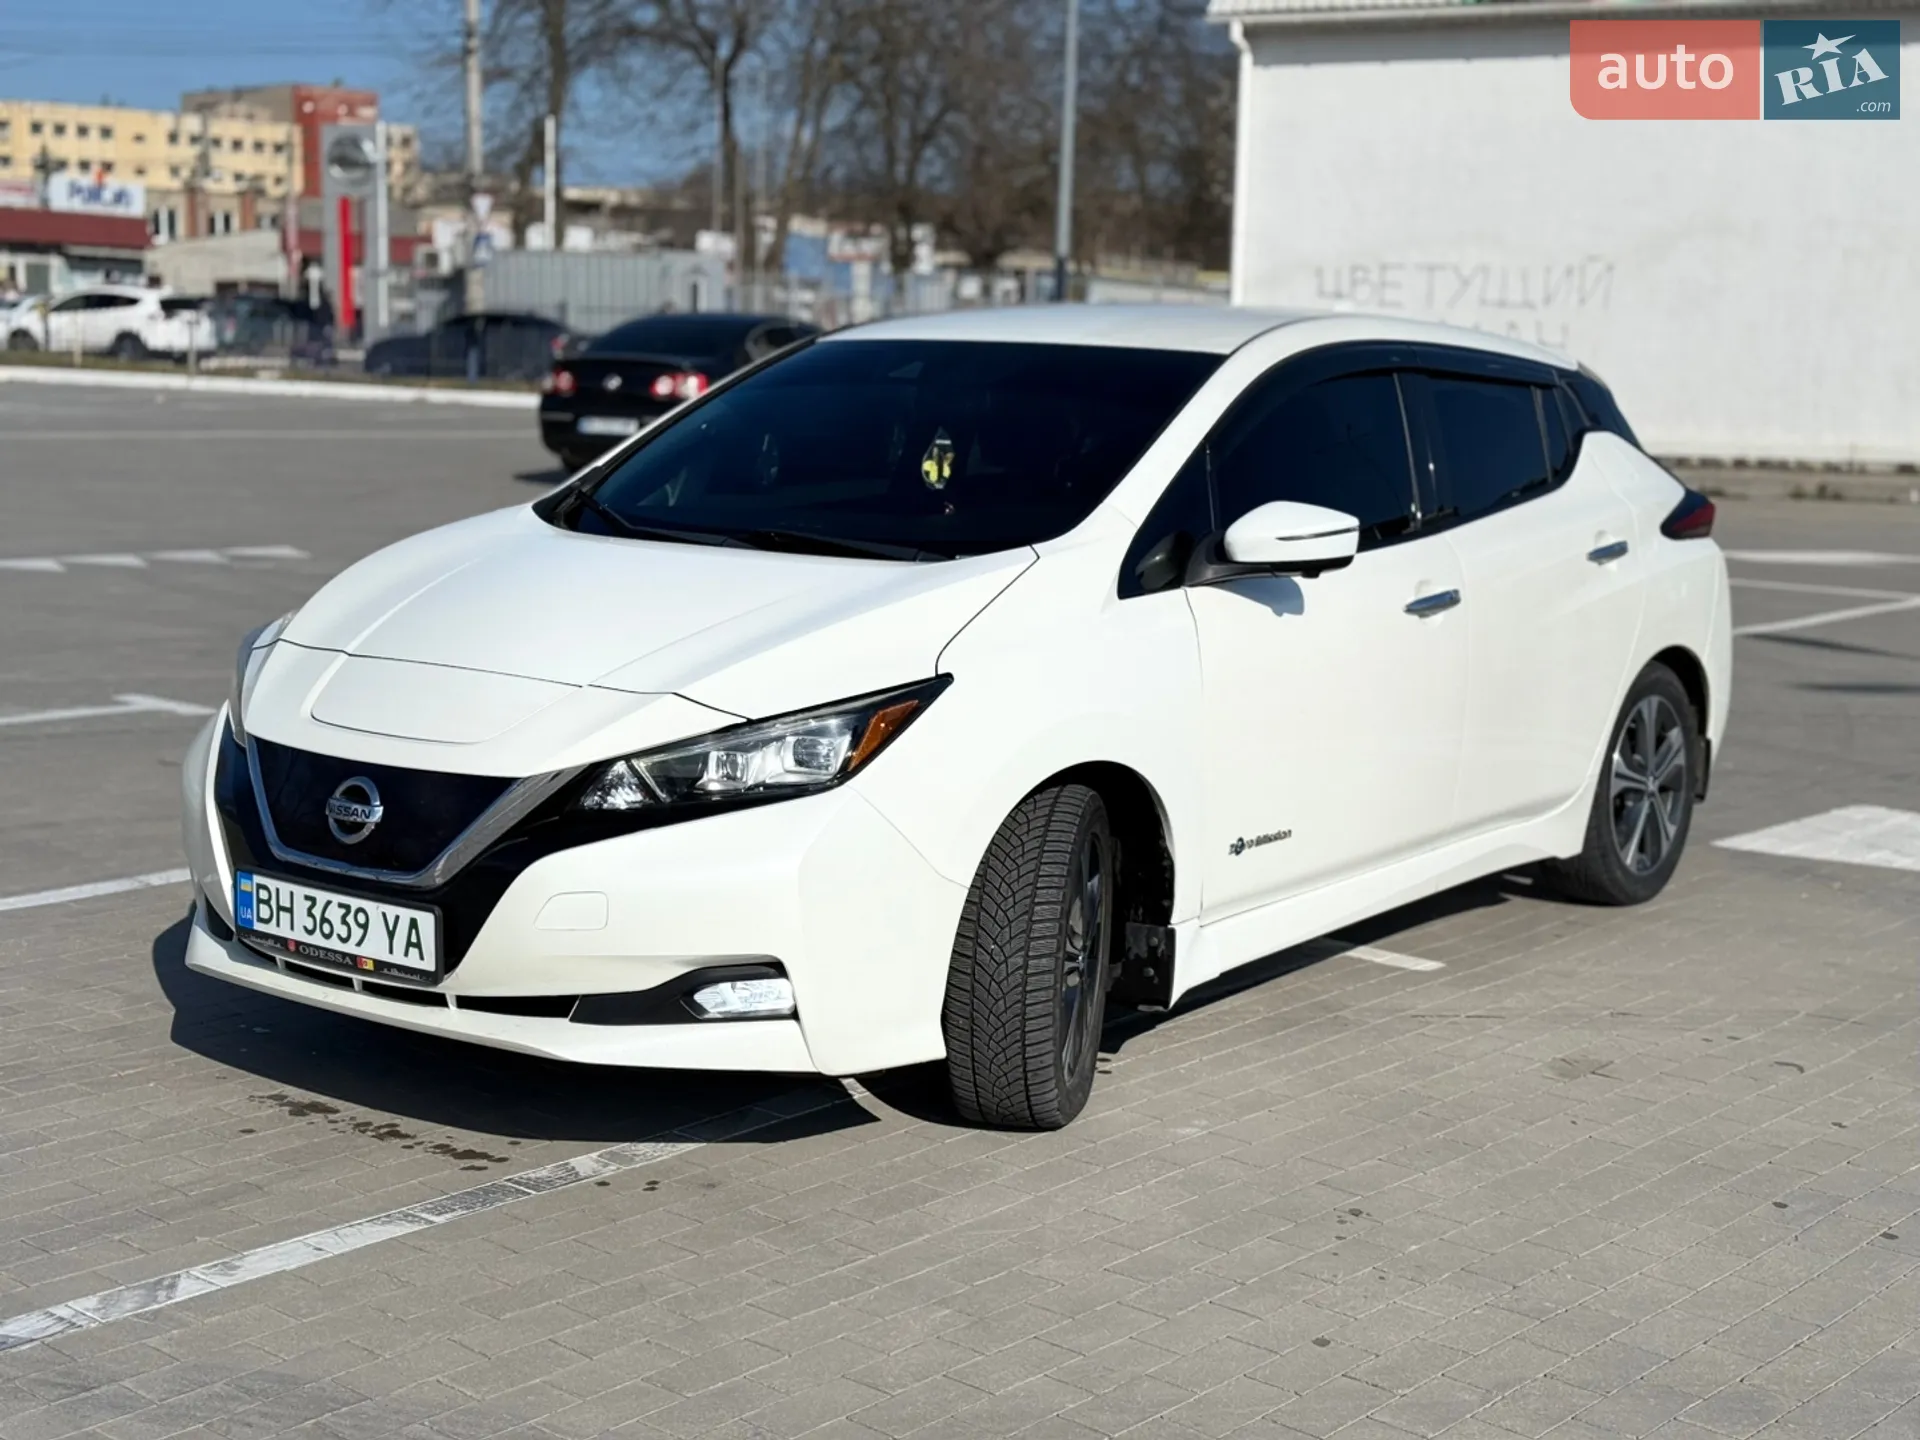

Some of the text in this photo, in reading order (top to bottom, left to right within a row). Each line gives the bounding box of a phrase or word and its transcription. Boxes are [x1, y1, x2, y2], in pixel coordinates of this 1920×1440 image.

[1313, 253, 1616, 311] ЦВЕТУЩИЙ
[329, 801, 371, 820] NISSAN
[240, 906, 253, 920] UA
[256, 882, 425, 961] BH 3639 YA
[299, 944, 354, 966] ODESSA
